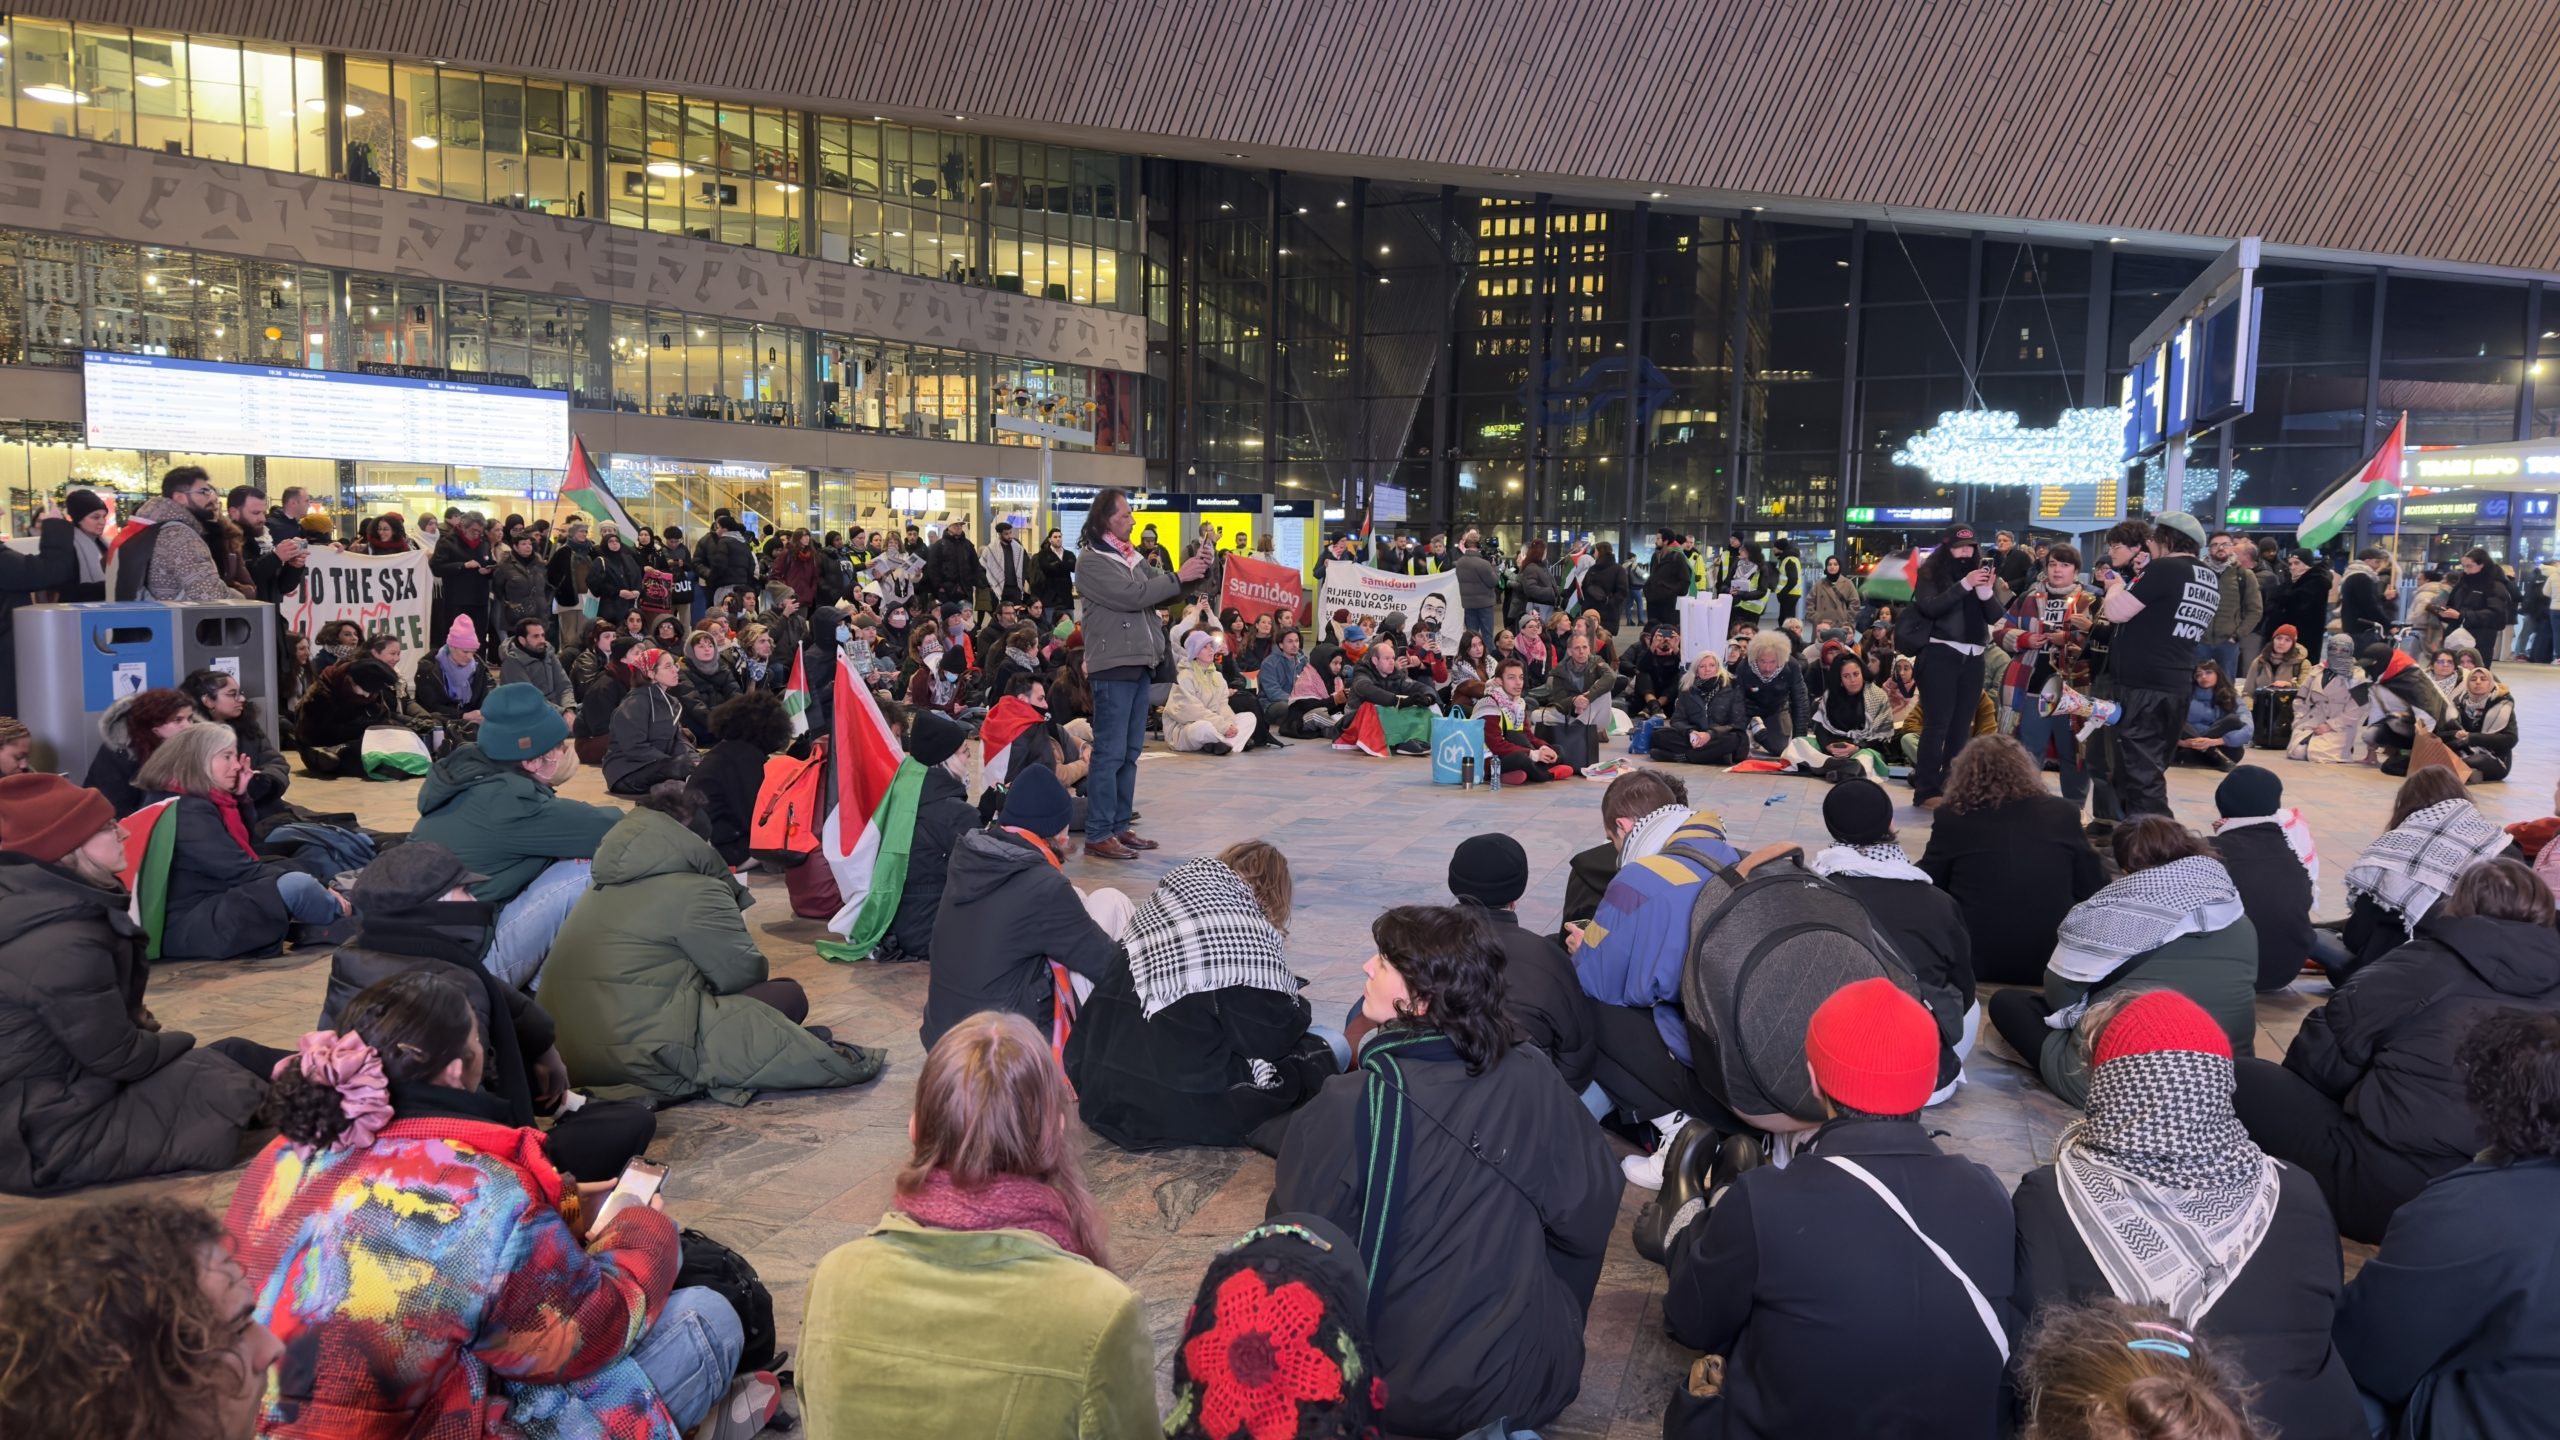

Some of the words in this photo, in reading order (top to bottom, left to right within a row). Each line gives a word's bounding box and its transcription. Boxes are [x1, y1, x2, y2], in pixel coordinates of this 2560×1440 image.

[1361, 576, 1416, 589] samidoun
[2197, 568, 2216, 585] JEWS
[298, 566, 325, 605] TO
[329, 567, 374, 604] THE
[378, 567, 418, 604] SEA
[1364, 592, 1393, 602] VOOR
[2045, 612, 2058, 621] IN
[366, 615, 424, 651] FREE
